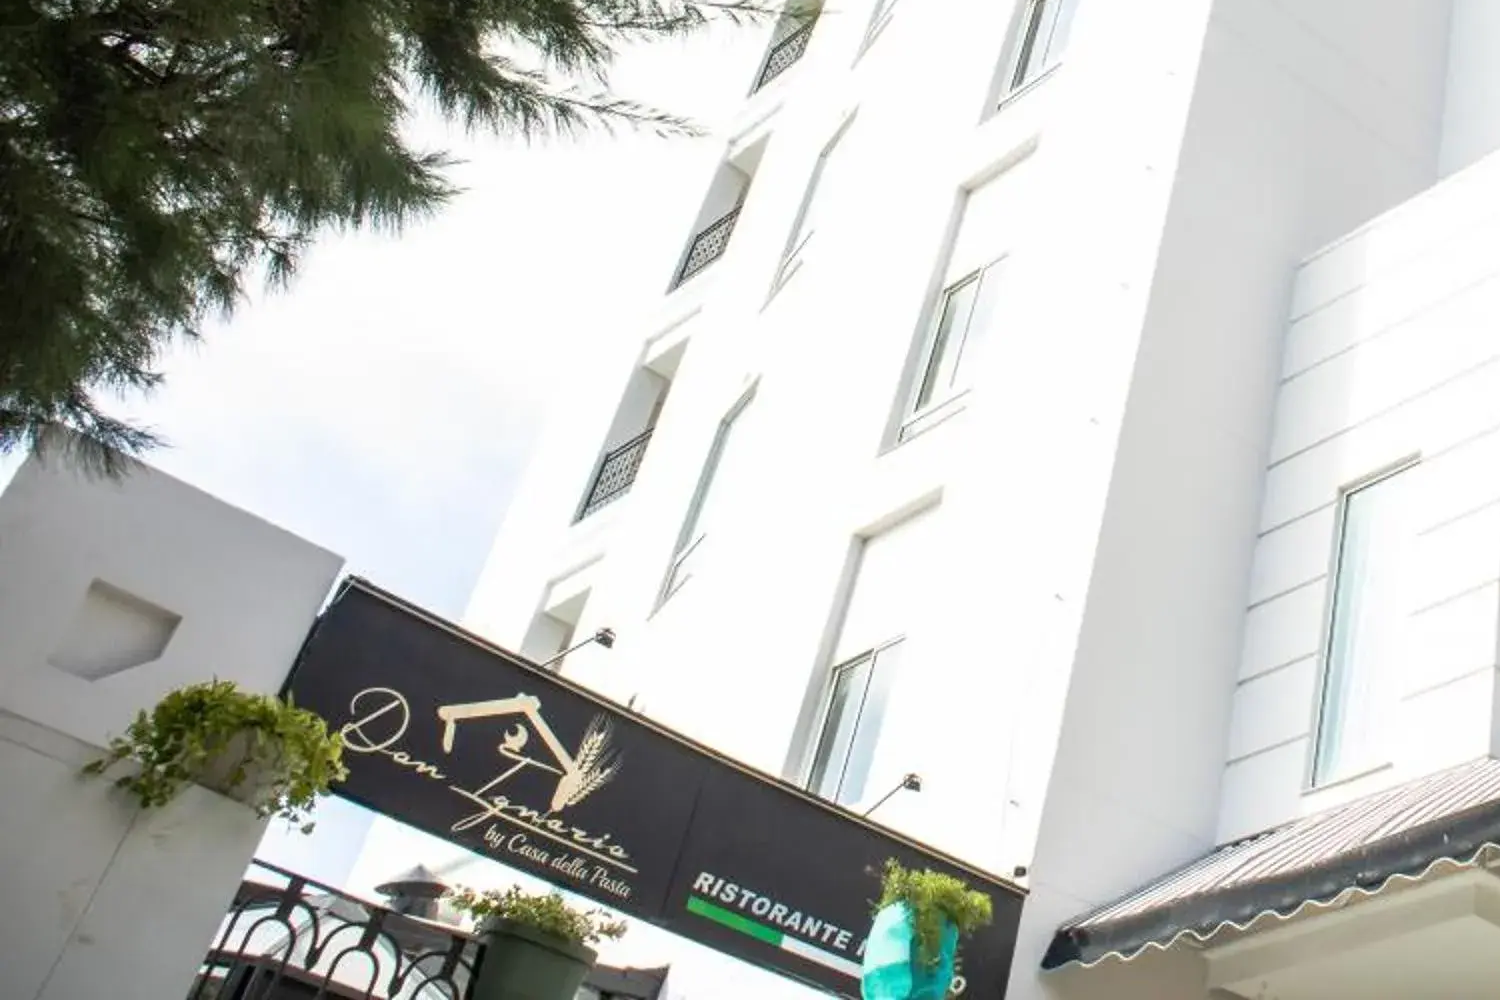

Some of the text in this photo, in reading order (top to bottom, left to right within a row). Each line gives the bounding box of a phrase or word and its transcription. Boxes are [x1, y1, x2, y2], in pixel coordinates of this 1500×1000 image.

[484, 823, 632, 898] by Casa della Pasta
[693, 871, 853, 951] RISTORANTE
